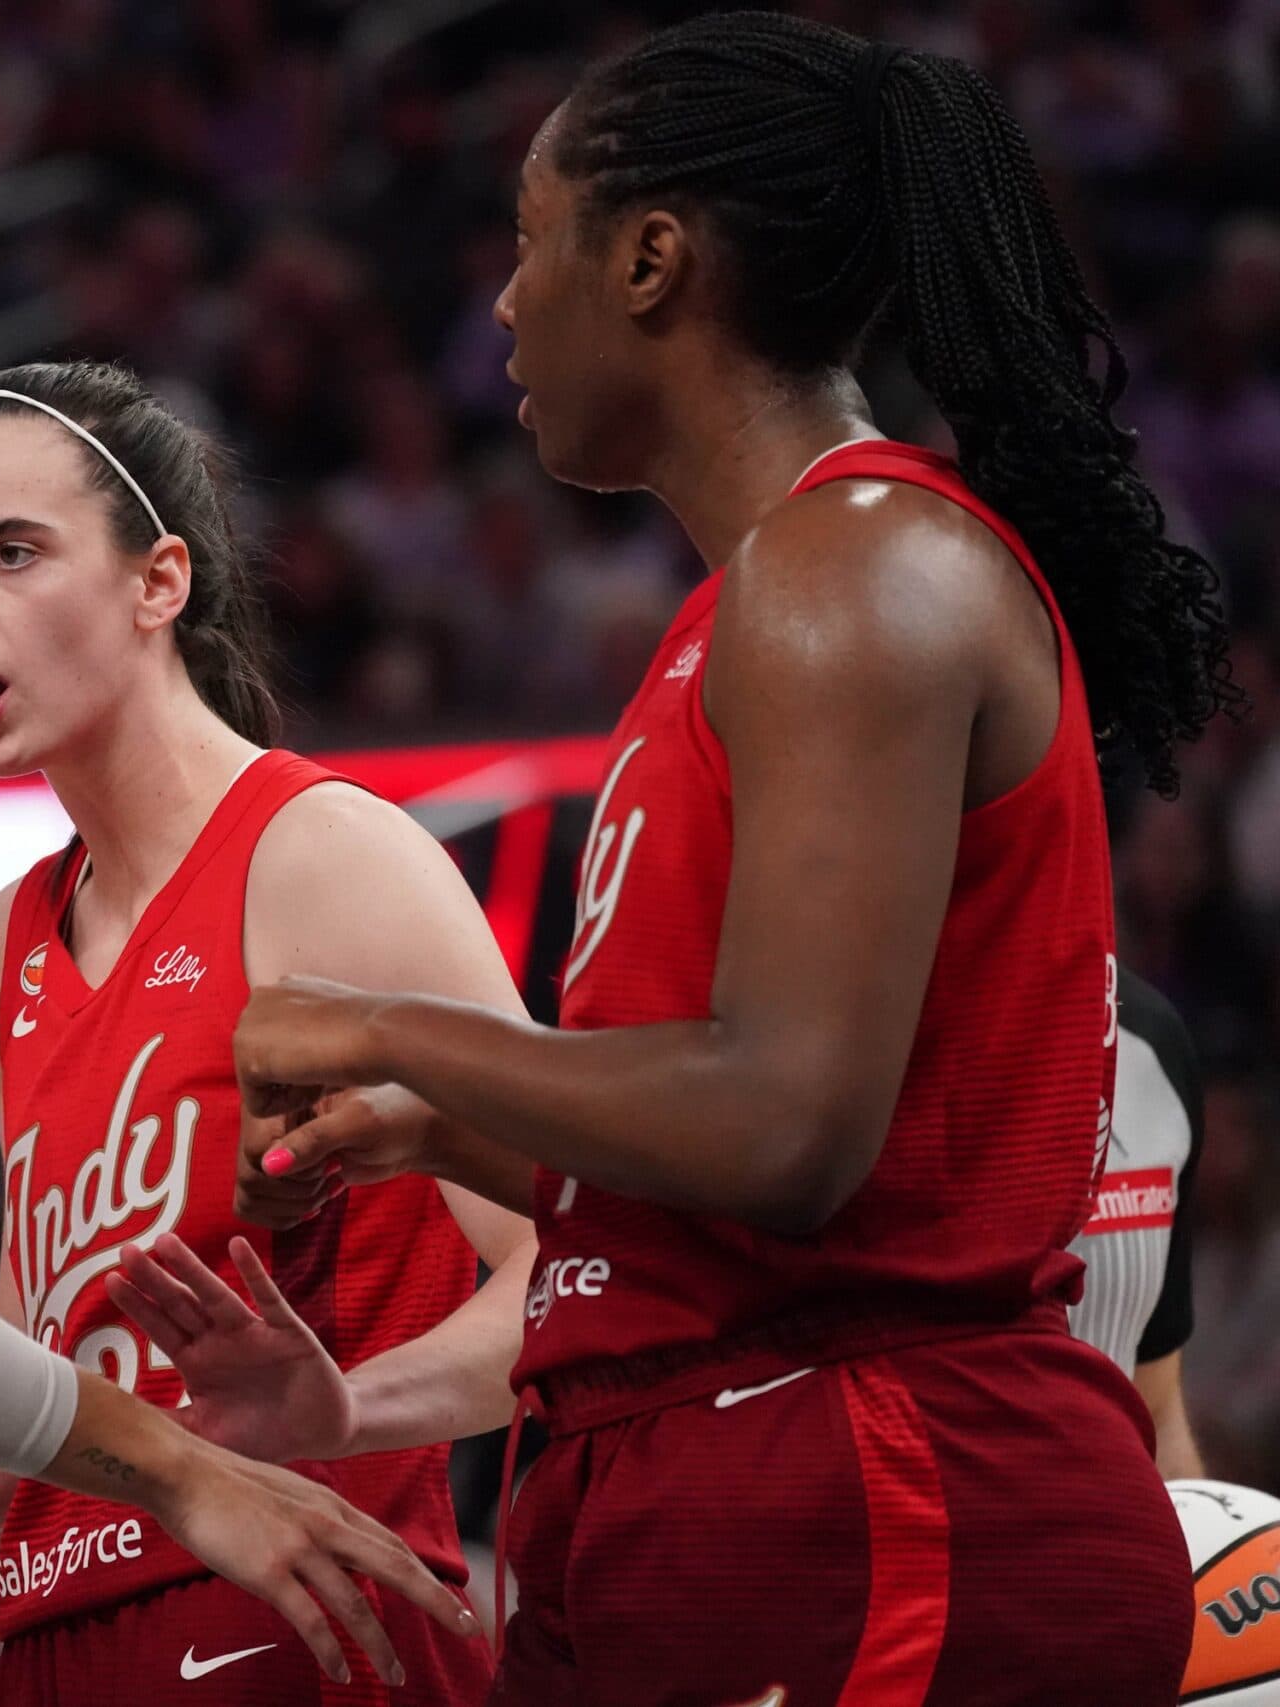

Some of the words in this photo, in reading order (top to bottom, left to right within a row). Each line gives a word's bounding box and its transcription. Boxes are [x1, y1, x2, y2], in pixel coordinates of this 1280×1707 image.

[144, 945, 207, 993] Lilly
[4, 1034, 201, 1346] Indy
[1088, 1182, 1174, 1222] mirates
